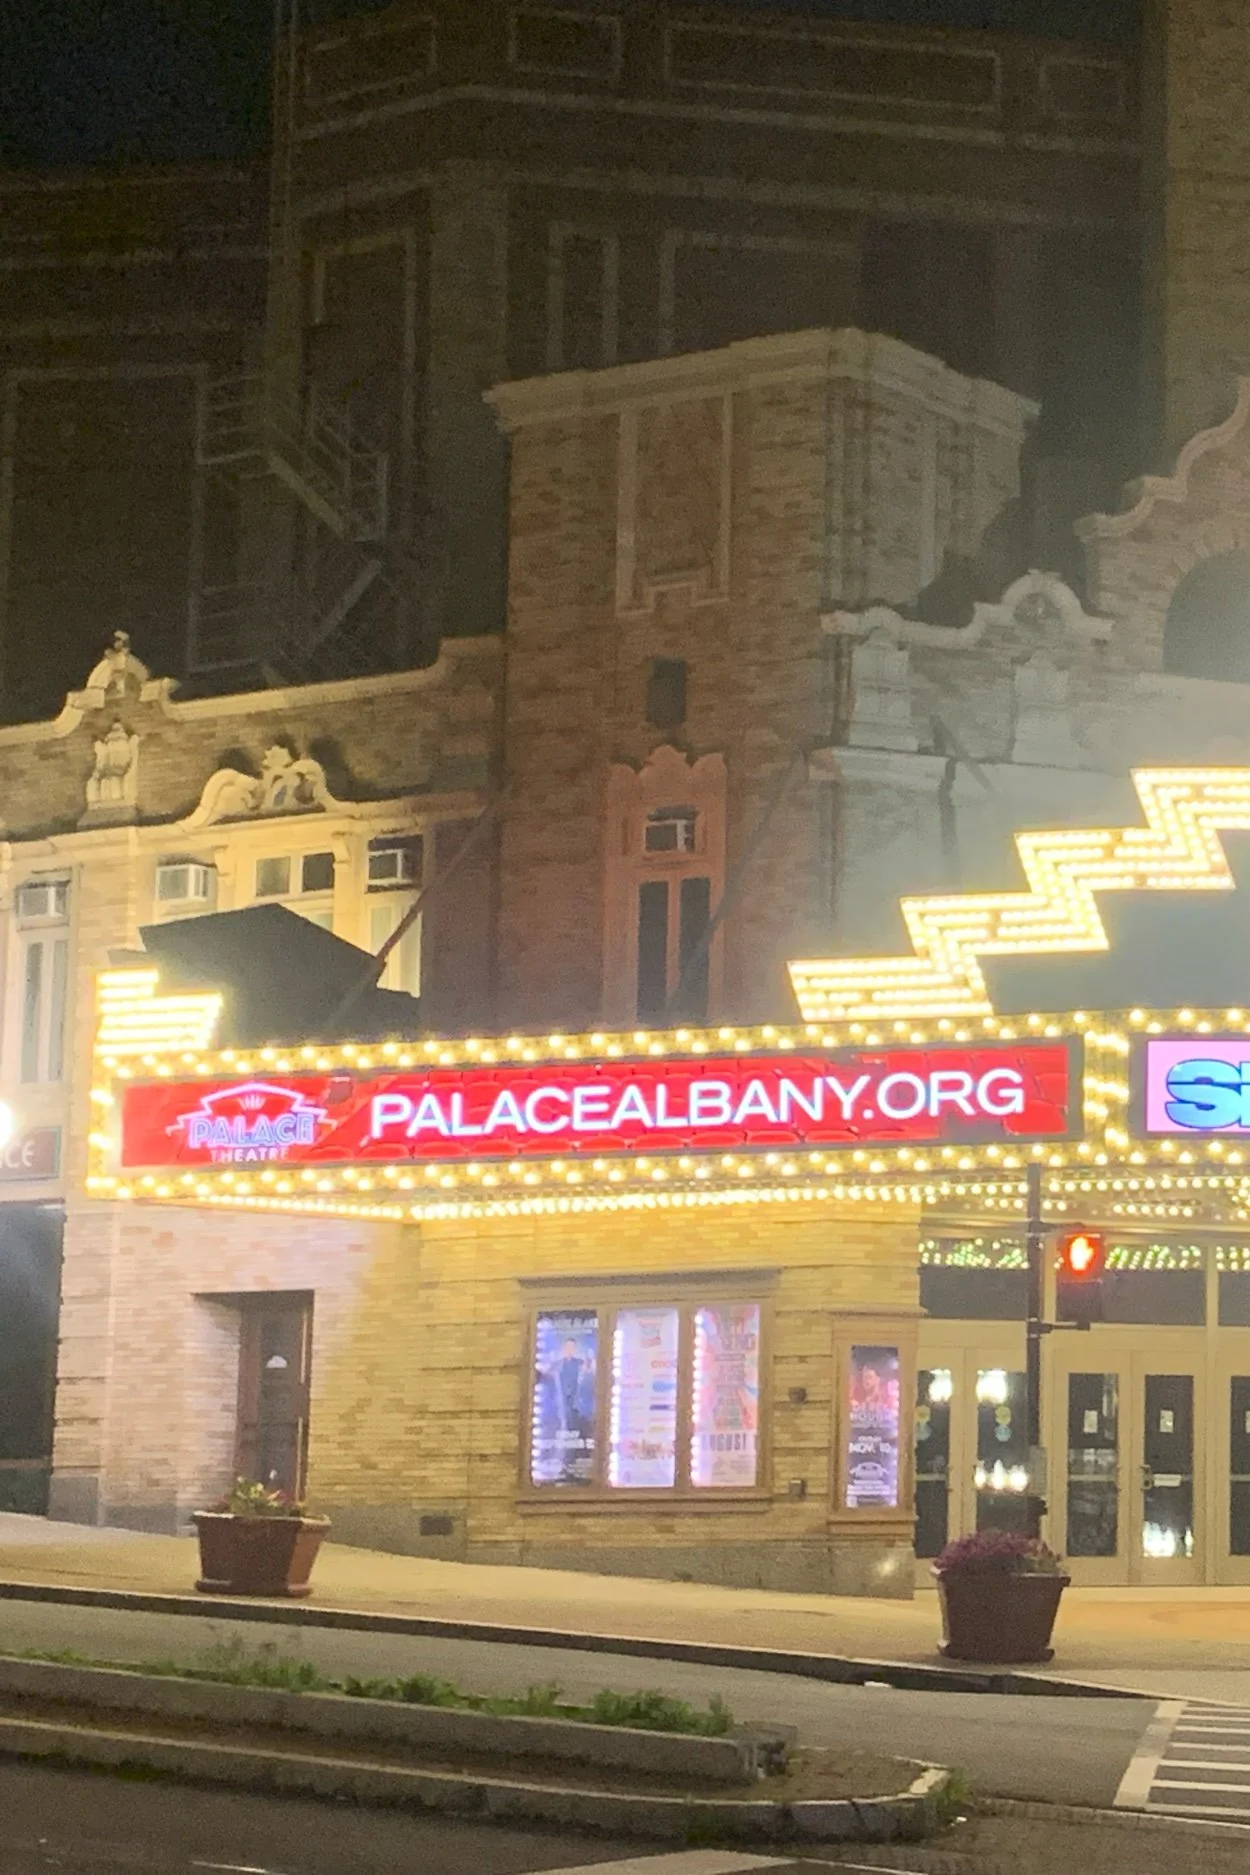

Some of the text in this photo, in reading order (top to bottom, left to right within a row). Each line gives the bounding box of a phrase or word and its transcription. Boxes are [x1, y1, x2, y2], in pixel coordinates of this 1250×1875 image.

[369, 1067, 1024, 1138] PALACEALBANY.ORG
[188, 1112, 316, 1148] PALACE
[0, 1140, 36, 1169] CE
[210, 1148, 289, 1163] THEATRE
